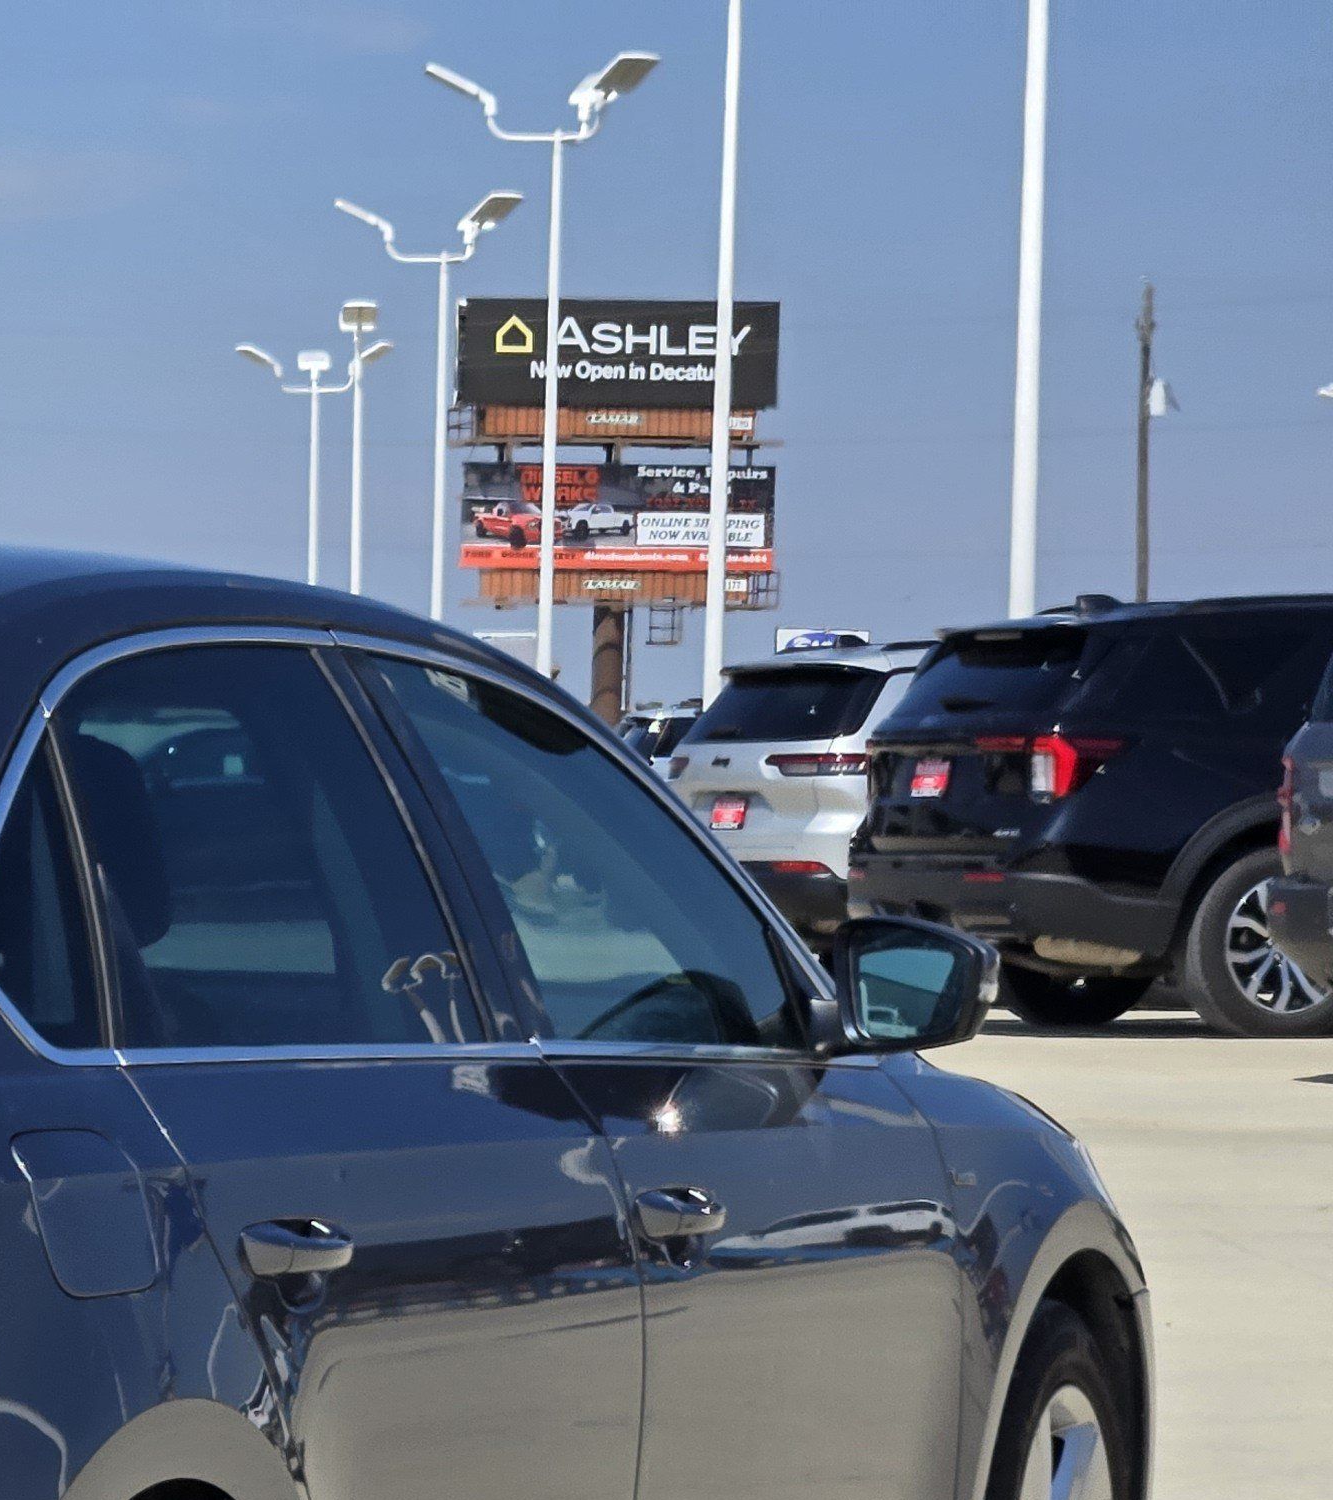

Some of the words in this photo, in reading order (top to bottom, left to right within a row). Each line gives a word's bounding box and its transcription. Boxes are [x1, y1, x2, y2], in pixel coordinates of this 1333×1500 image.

[555, 315, 751, 356] ASHLEY
[530, 360, 572, 379] Nw
[575, 360, 626, 382] Open
[628, 361, 646, 381] in
[649, 362, 716, 382] Decatu
[637, 465, 701, 481] Service,
[641, 517, 692, 528] ONLINE
[693, 518, 760, 530] SHPING
[648, 530, 680, 541] NOW
[681, 531, 753, 542] AVABLE
